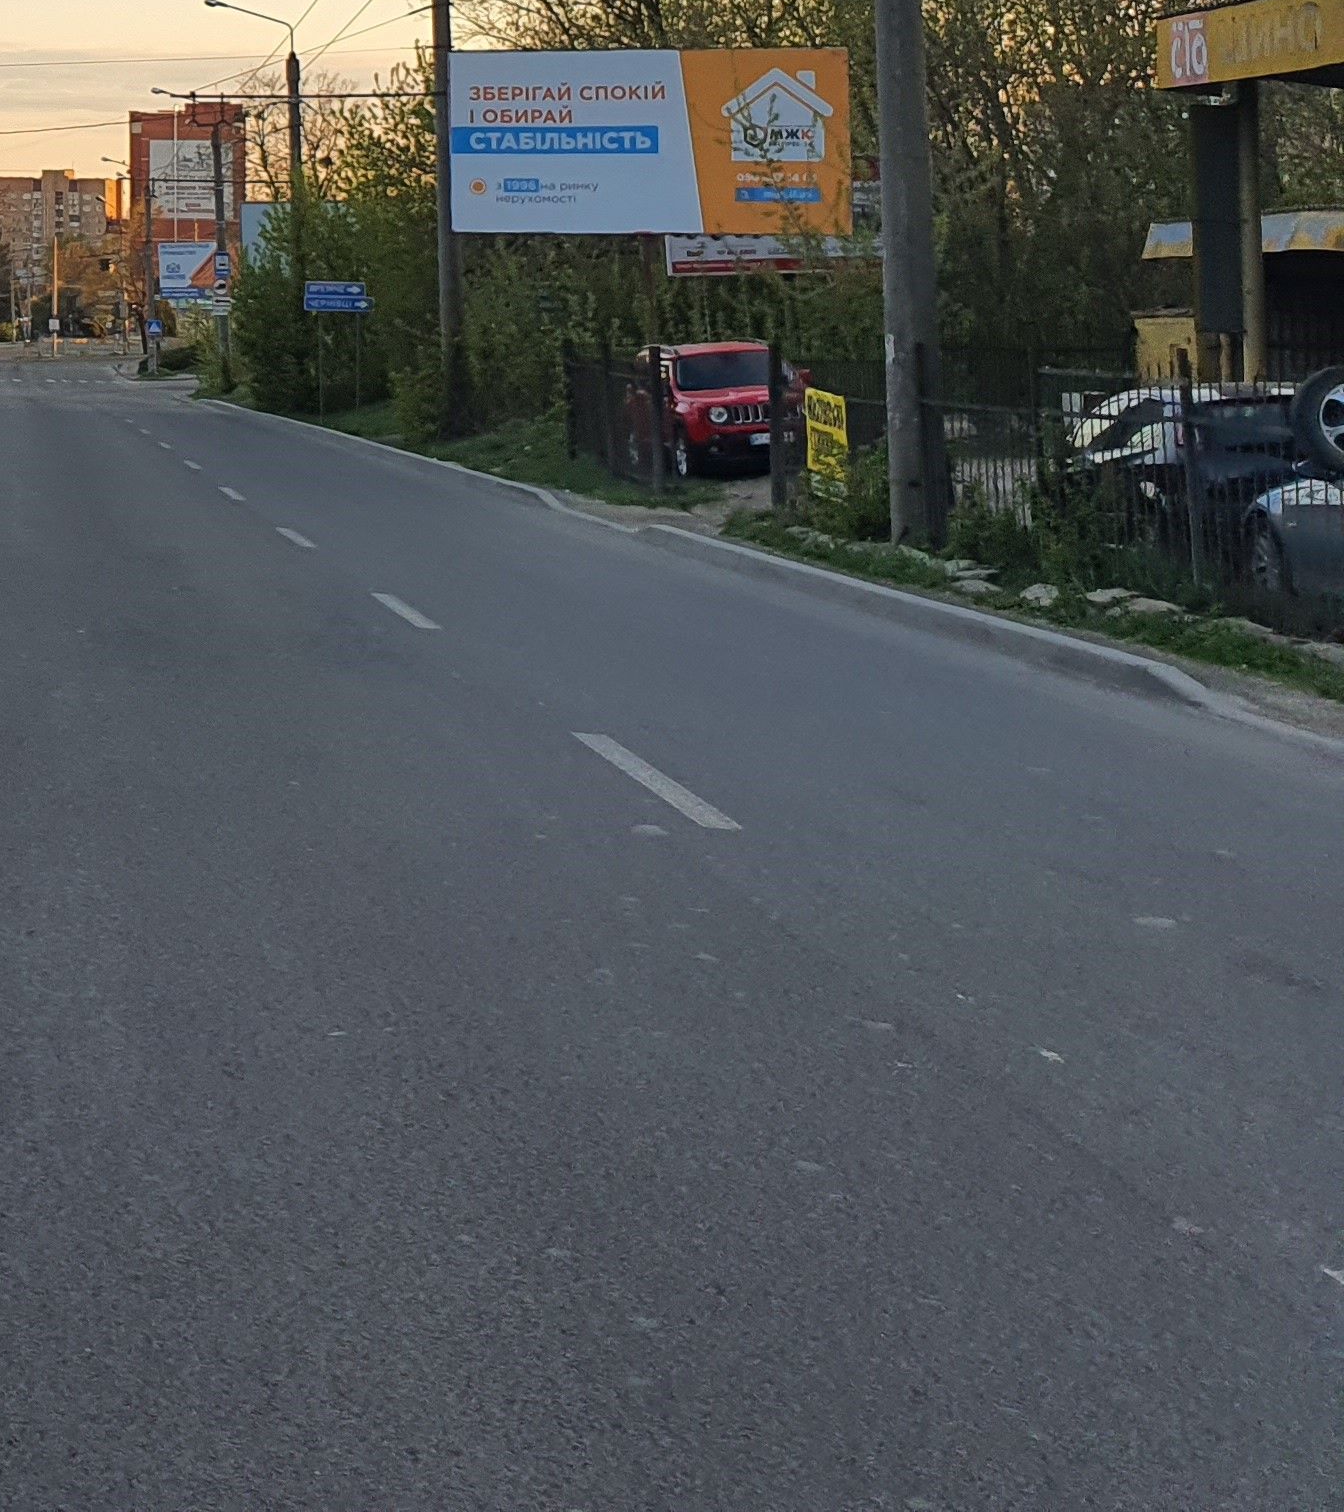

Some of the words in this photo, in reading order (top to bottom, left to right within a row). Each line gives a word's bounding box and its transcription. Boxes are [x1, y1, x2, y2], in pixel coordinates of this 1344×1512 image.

[469, 81, 572, 101] ЗБЕРІГАЙ
[579, 80, 666, 101] СПОКІЙ
[482, 104, 573, 124] ОБИРАЙ
[469, 131, 652, 151] СТАБІЛЬНІСТЬ
[560, 182, 599, 193] ринку
